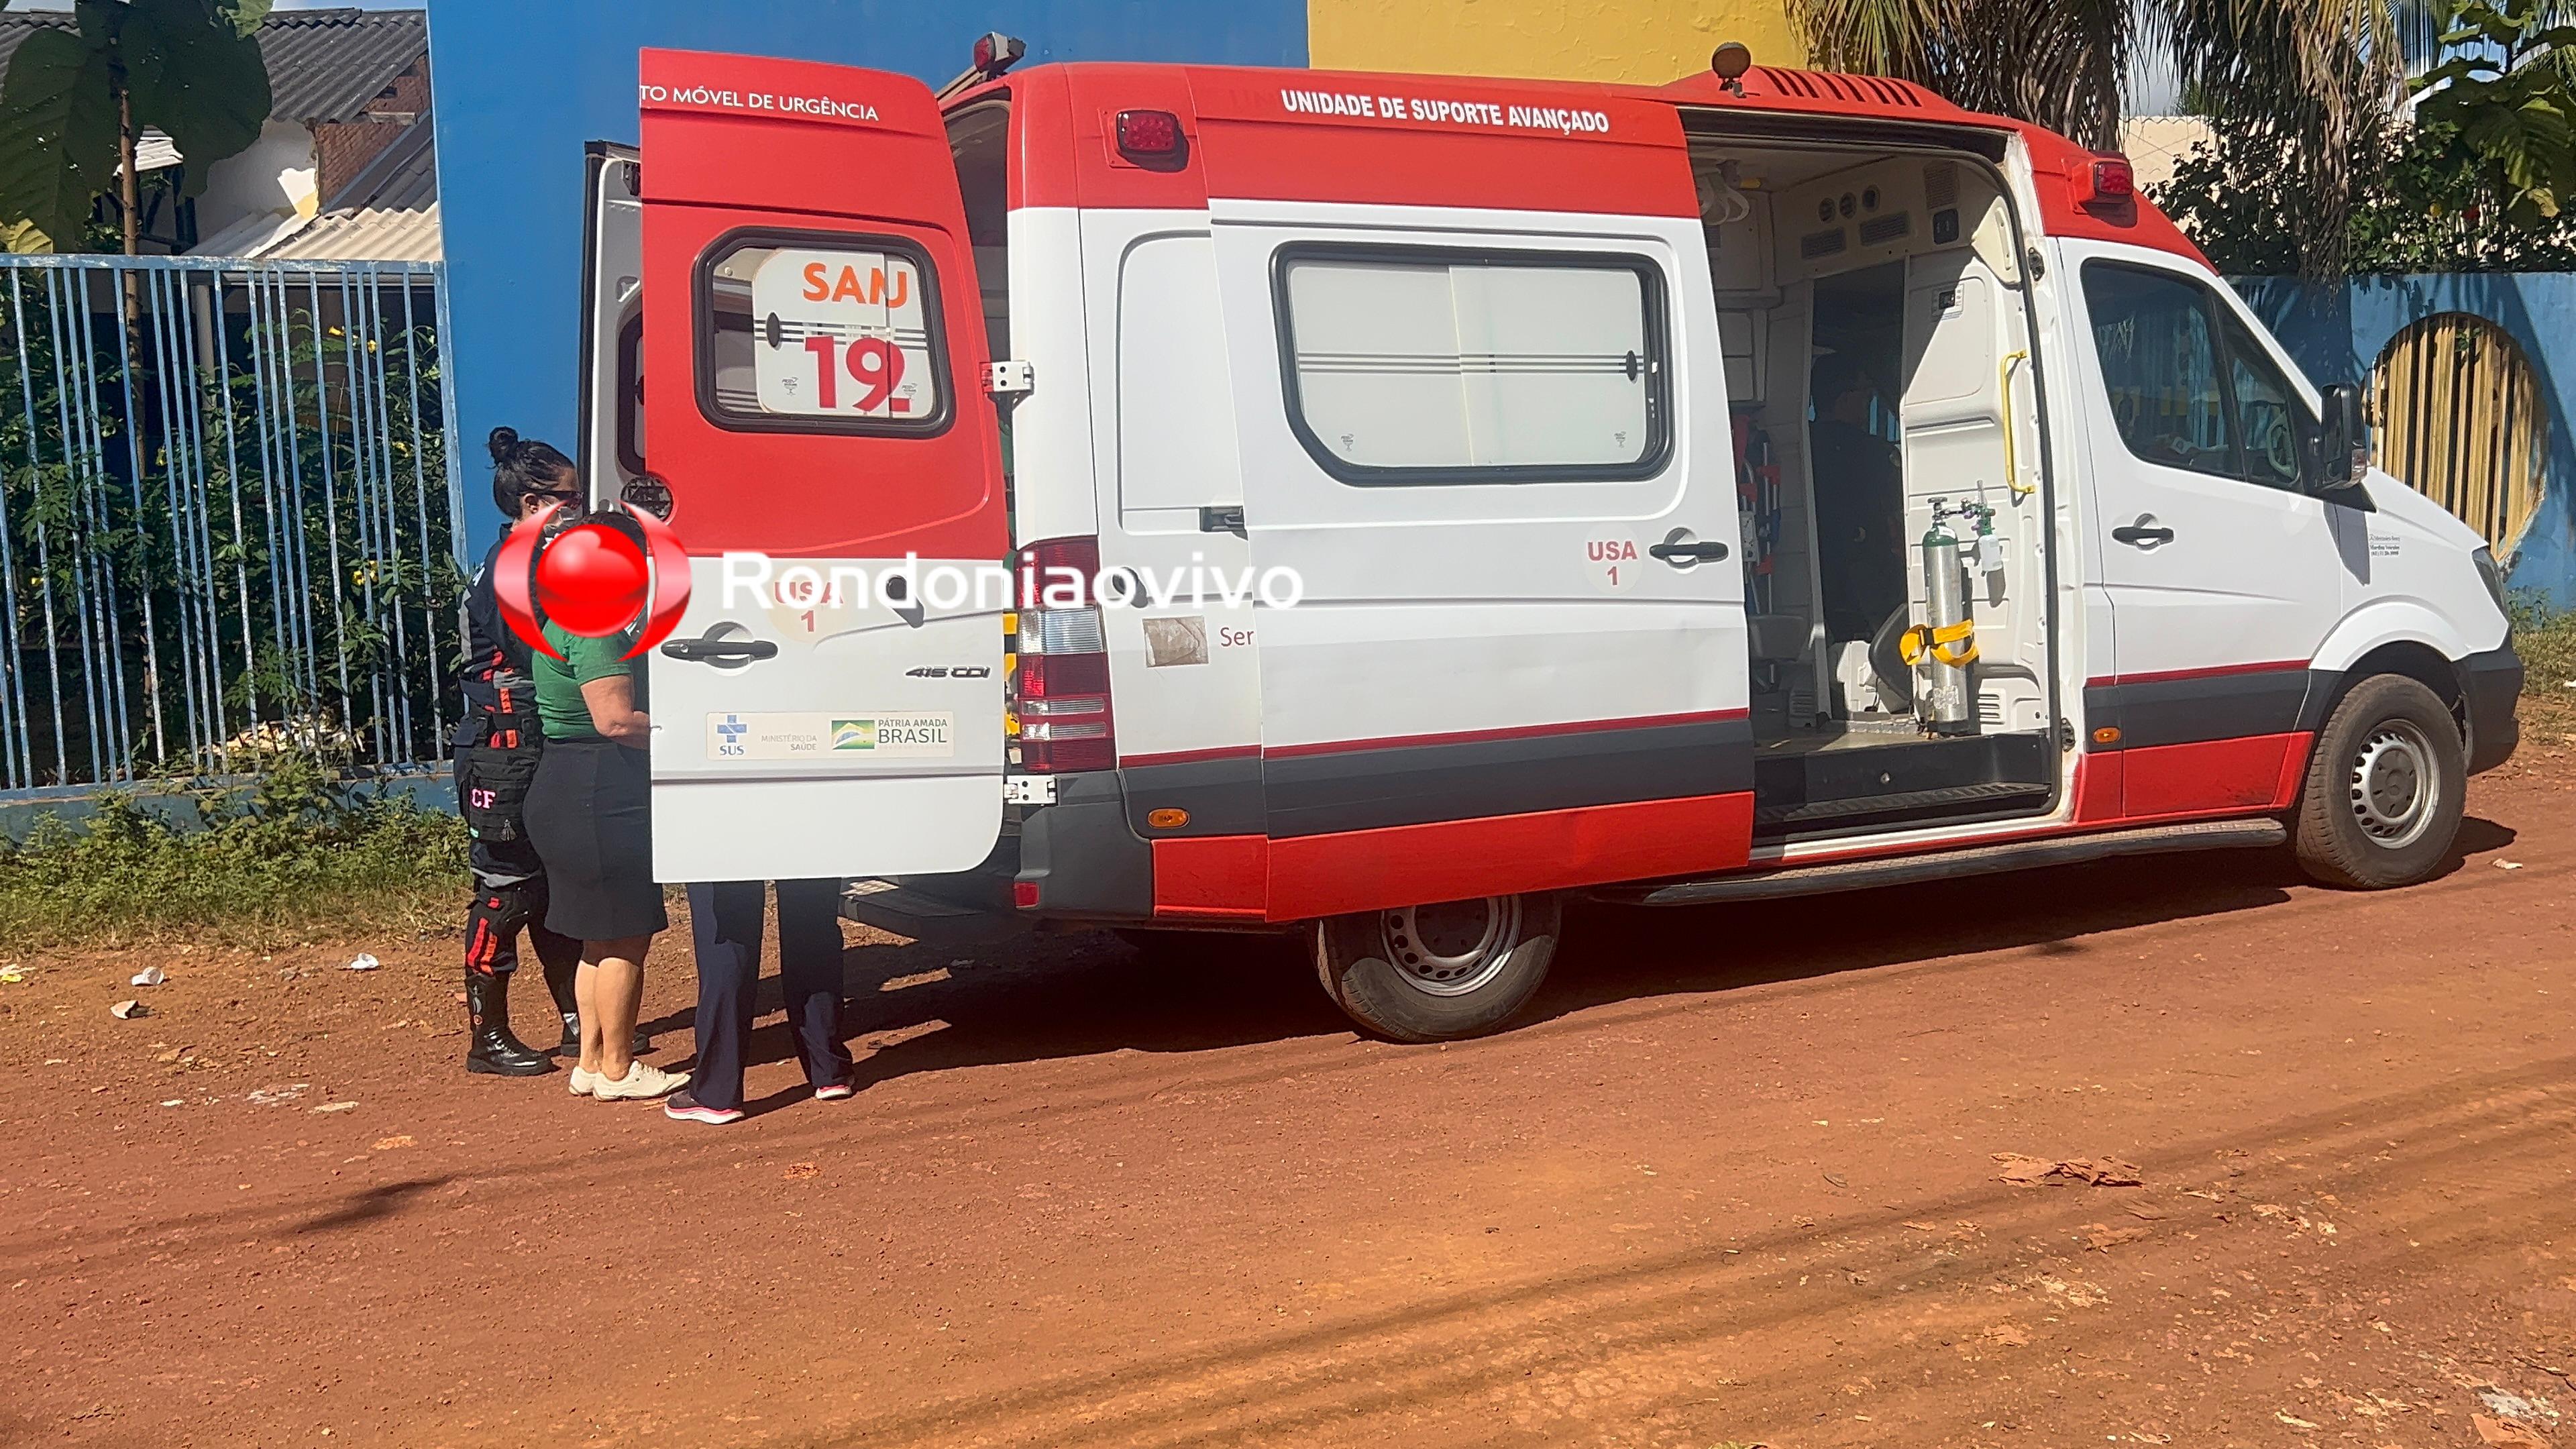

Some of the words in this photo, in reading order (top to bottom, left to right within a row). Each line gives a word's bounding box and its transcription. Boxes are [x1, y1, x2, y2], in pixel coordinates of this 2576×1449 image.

[639, 85, 667, 101] TO
[673, 85, 743, 107] MÓVEL
[749, 93, 773, 109] DE
[780, 96, 879, 121] URGÊNCIA
[1281, 89, 1375, 118] UNIDADE
[1378, 97, 1407, 119] DE
[1411, 99, 1503, 125] SUPORTE
[1508, 105, 1609, 136] AVANÇADO
[1587, 541, 1638, 561] USA
[1607, 566, 1617, 586] 1
[801, 610, 814, 632] 1
[1220, 627, 1254, 647] Ser
[906, 667, 947, 678] 415
[951, 667, 990, 678] CDI
[879, 718, 910, 727] PÁTRIA
[914, 718, 947, 727] AMADA
[761, 734, 805, 742] MINISTÉRIO
[879, 728, 947, 744] BRASIL
[720, 745, 744, 755] SUS
[791, 742, 816, 751] SAÚDE
